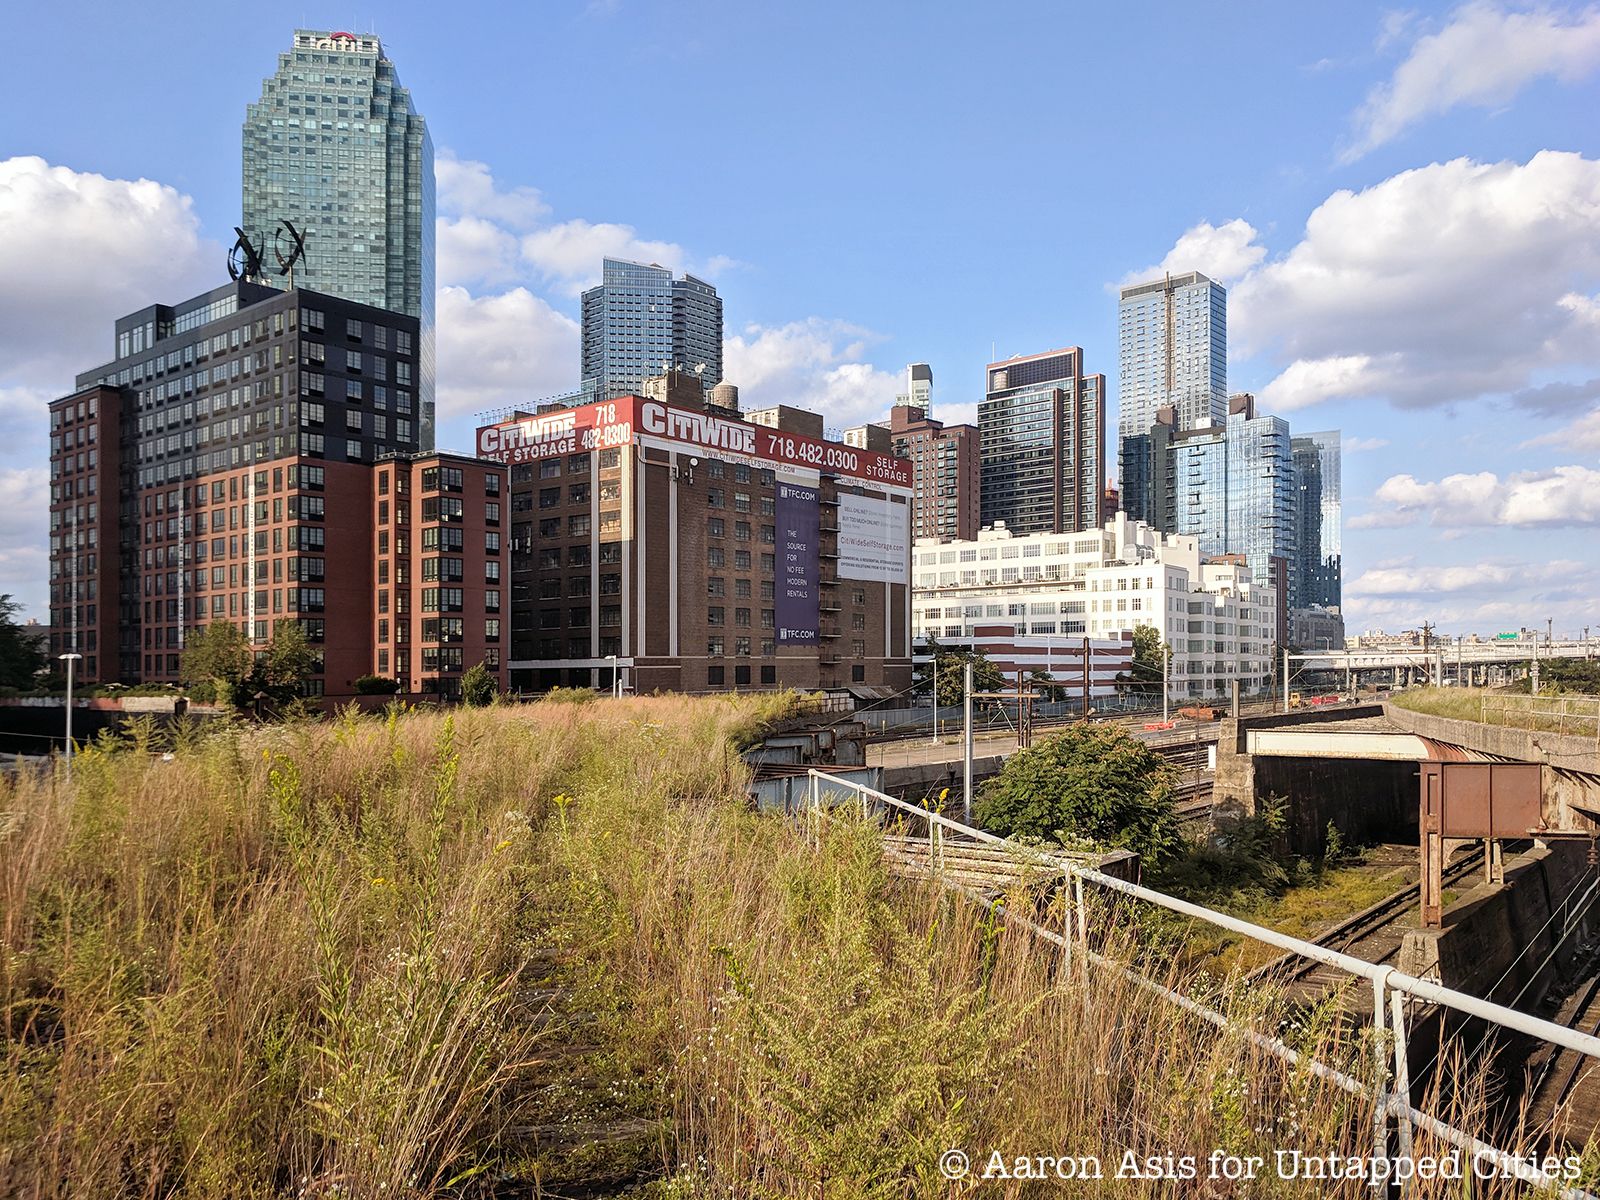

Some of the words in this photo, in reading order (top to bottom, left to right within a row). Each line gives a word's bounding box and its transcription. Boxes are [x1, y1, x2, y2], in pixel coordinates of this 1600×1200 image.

[316, 35, 356, 52] citi
[595, 403, 616, 426] 718
[581, 421, 631, 450] 482-0300
[513, 438, 576, 462] STORAGE
[767, 434, 858, 472] 718.482.0300
[876, 456, 898, 470] SELF
[866, 464, 908, 483] STORAGE
[787, 488, 816, 501] TFC.COM
[787, 529, 797, 538] THE
[786, 542, 807, 551] SOURCE
[786, 553, 798, 562] FOR
[786, 566, 795, 574] NO
[795, 566, 805, 575] FEE
[786, 578, 808, 587] MODERN
[786, 589, 808, 599] RENTALS
[787, 630, 815, 639] TFC.COM
